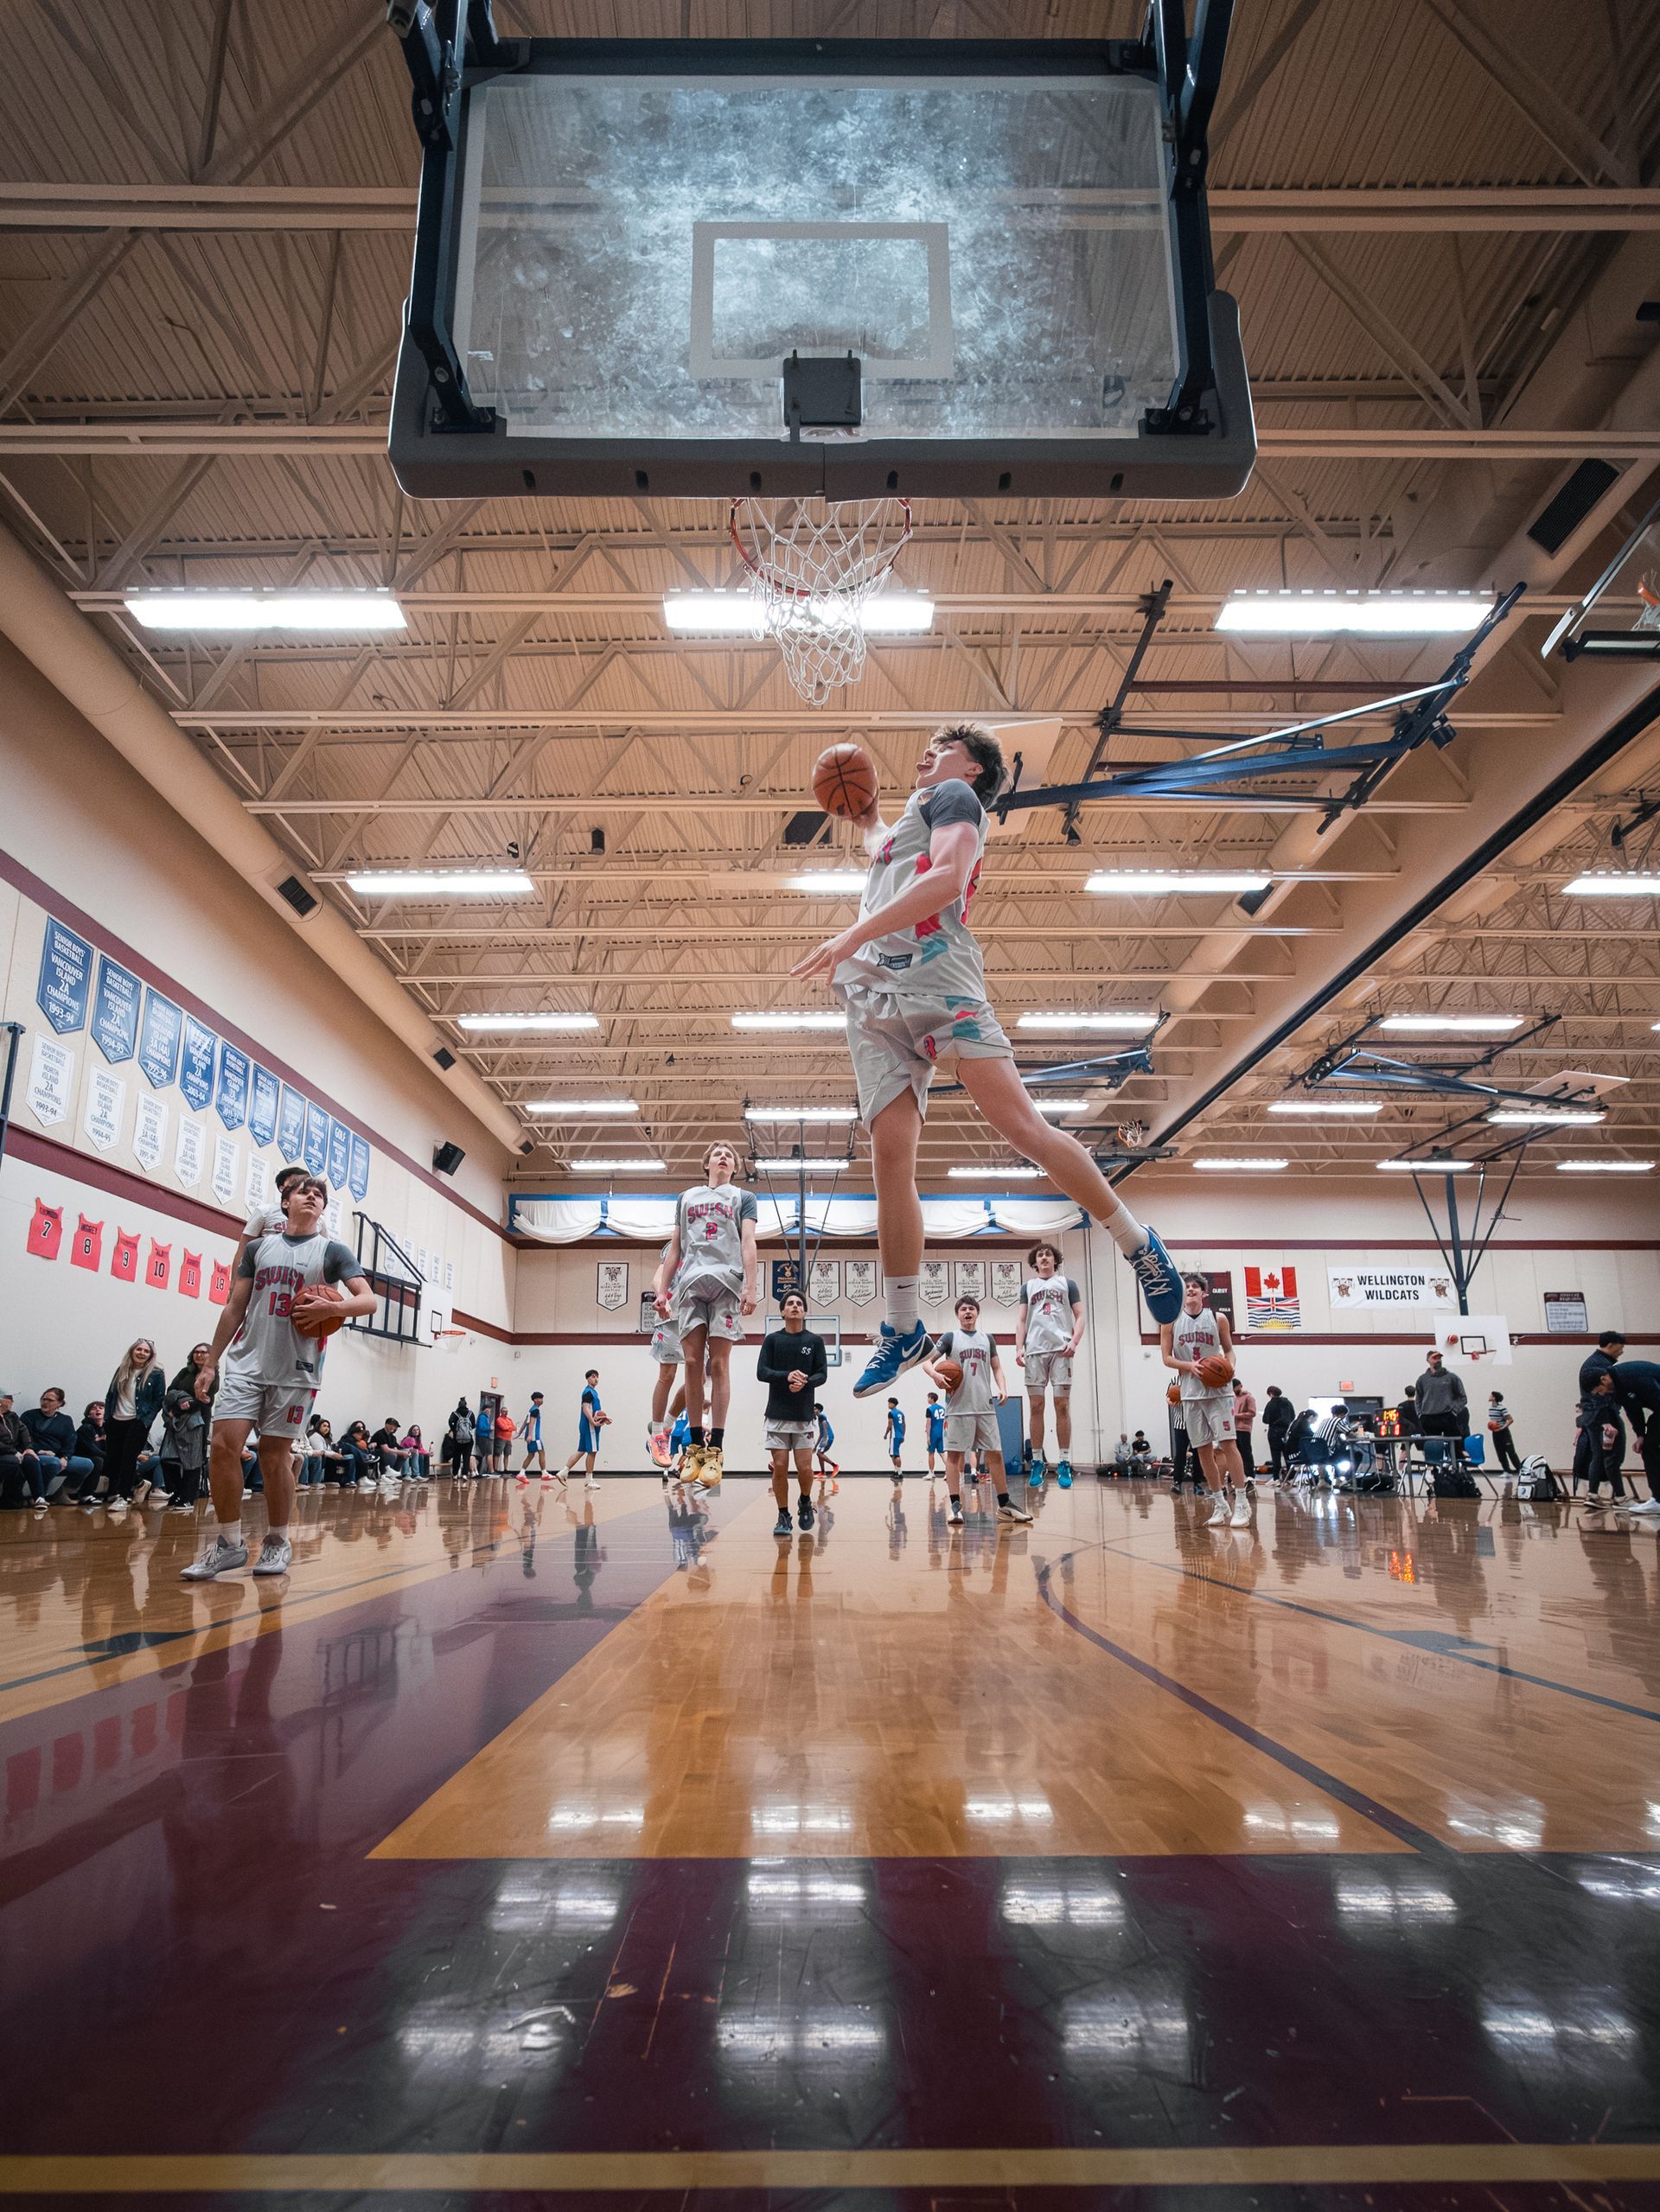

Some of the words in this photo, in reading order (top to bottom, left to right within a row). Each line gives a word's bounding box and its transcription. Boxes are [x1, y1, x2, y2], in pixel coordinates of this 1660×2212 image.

[54, 931, 72, 948] SENIOR
[54, 940, 83, 966] BASKETBALL
[51, 953, 84, 981] VANCOUVER
[105, 967, 122, 983] SENIOR
[55, 966, 76, 986] ISLAND
[59, 979, 69, 995] 2A
[105, 976, 132, 999] BASKETBALL
[47, 985, 80, 1010] CHAMPIONS
[103, 987, 132, 1014] VANCOUVER
[48, 1001, 74, 1024] 1993-94
[107, 1000, 126, 1018] ISLAND
[111, 1012, 120, 1027] 2A
[99, 1017, 129, 1041] CHAMPIONS
[101, 1033, 124, 1054] 1994-95
[146, 1046, 171, 1068] CHAMPIONS
[42, 1072, 59, 1085] ISLAND
[43, 1063, 60, 1077] NORTH
[194, 1065, 202, 1079] 2A
[44, 1081, 54, 1093] 2A
[186, 1071, 209, 1091] CHAMPIONS
[34, 1087, 62, 1106] CHAMPIONS
[99, 1093, 113, 1104] NORTH
[35, 1100, 57, 1117] 1993-94
[97, 1100, 112, 1112] ISLAND
[99, 1109, 108, 1119] 2A
[91, 1114, 115, 1131] CHAMPIONS
[334, 1128, 347, 1142] GOLF
[687, 1202, 735, 1224] SWISH
[42, 1221, 51, 1238] 7
[706, 1221, 718, 1240] 2
[83, 1238, 92, 1255] 8
[122, 1251, 130, 1269] 9
[154, 1260, 165, 1278] 10
[187, 1270, 196, 1286] 11
[215, 1276, 225, 1291] 18
[1357, 1275, 1425, 1286] WELLINGTON
[1031, 1289, 1063, 1306] SWISH
[1364, 1290, 1420, 1300] WILDCATS
[268, 1291, 291, 1317] 13
[1178, 1331, 1215, 1347] SWISH
[801, 1346, 812, 1355] SS
[959, 1348, 986, 1362] SWISH
[970, 1362, 978, 1376] 7
[286, 1404, 304, 1425] 13
[897, 1413, 903, 1424] 3
[934, 1408, 945, 1420] 42
[1223, 1420, 1230, 1431] 5
